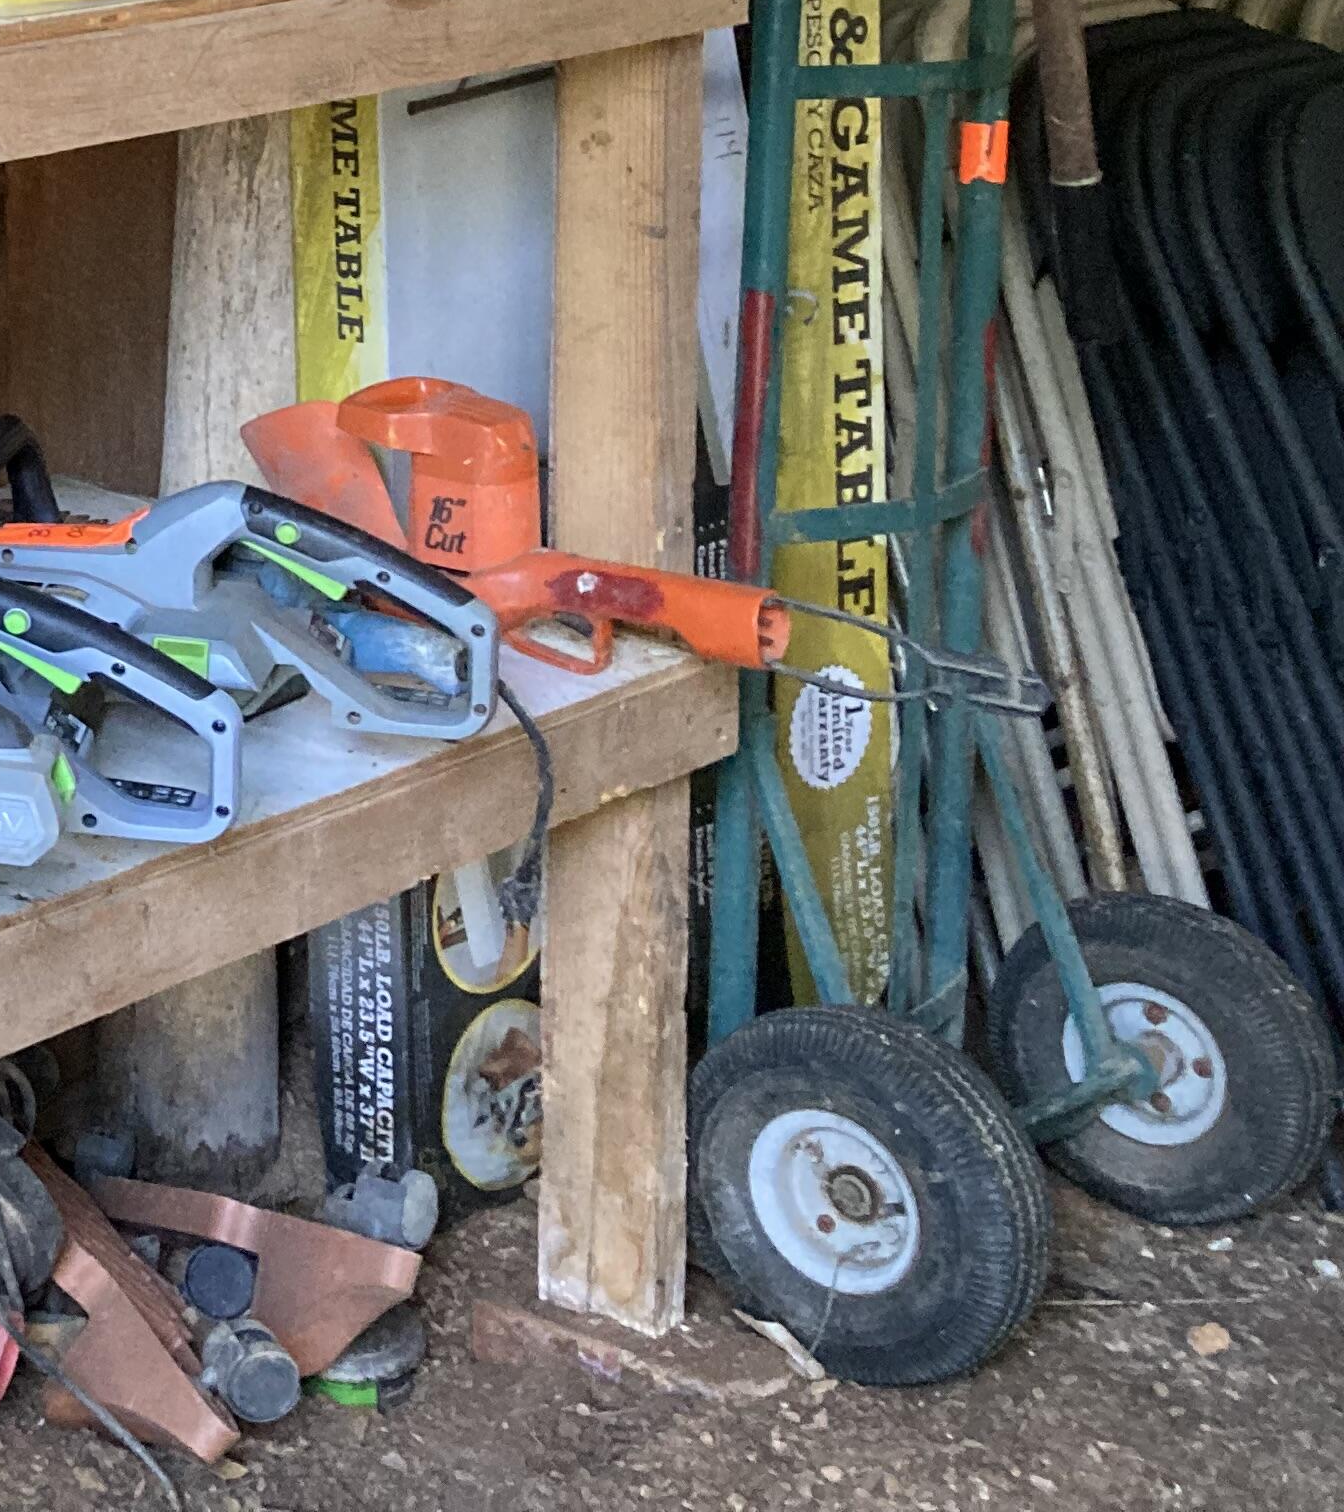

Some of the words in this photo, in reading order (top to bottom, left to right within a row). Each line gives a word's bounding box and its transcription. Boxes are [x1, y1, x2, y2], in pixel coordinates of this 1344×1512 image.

[829, 7, 869, 66] &
[330, 98, 361, 179] ME
[806, 127, 825, 212] CAZA
[831, 98, 871, 346] GAME
[333, 187, 365, 344] TABLE
[424, 530, 467, 555] Cut
[831, 682, 846, 771] imited
[375, 905, 392, 968] 50LB.
[375, 972, 394, 1041] LOAD
